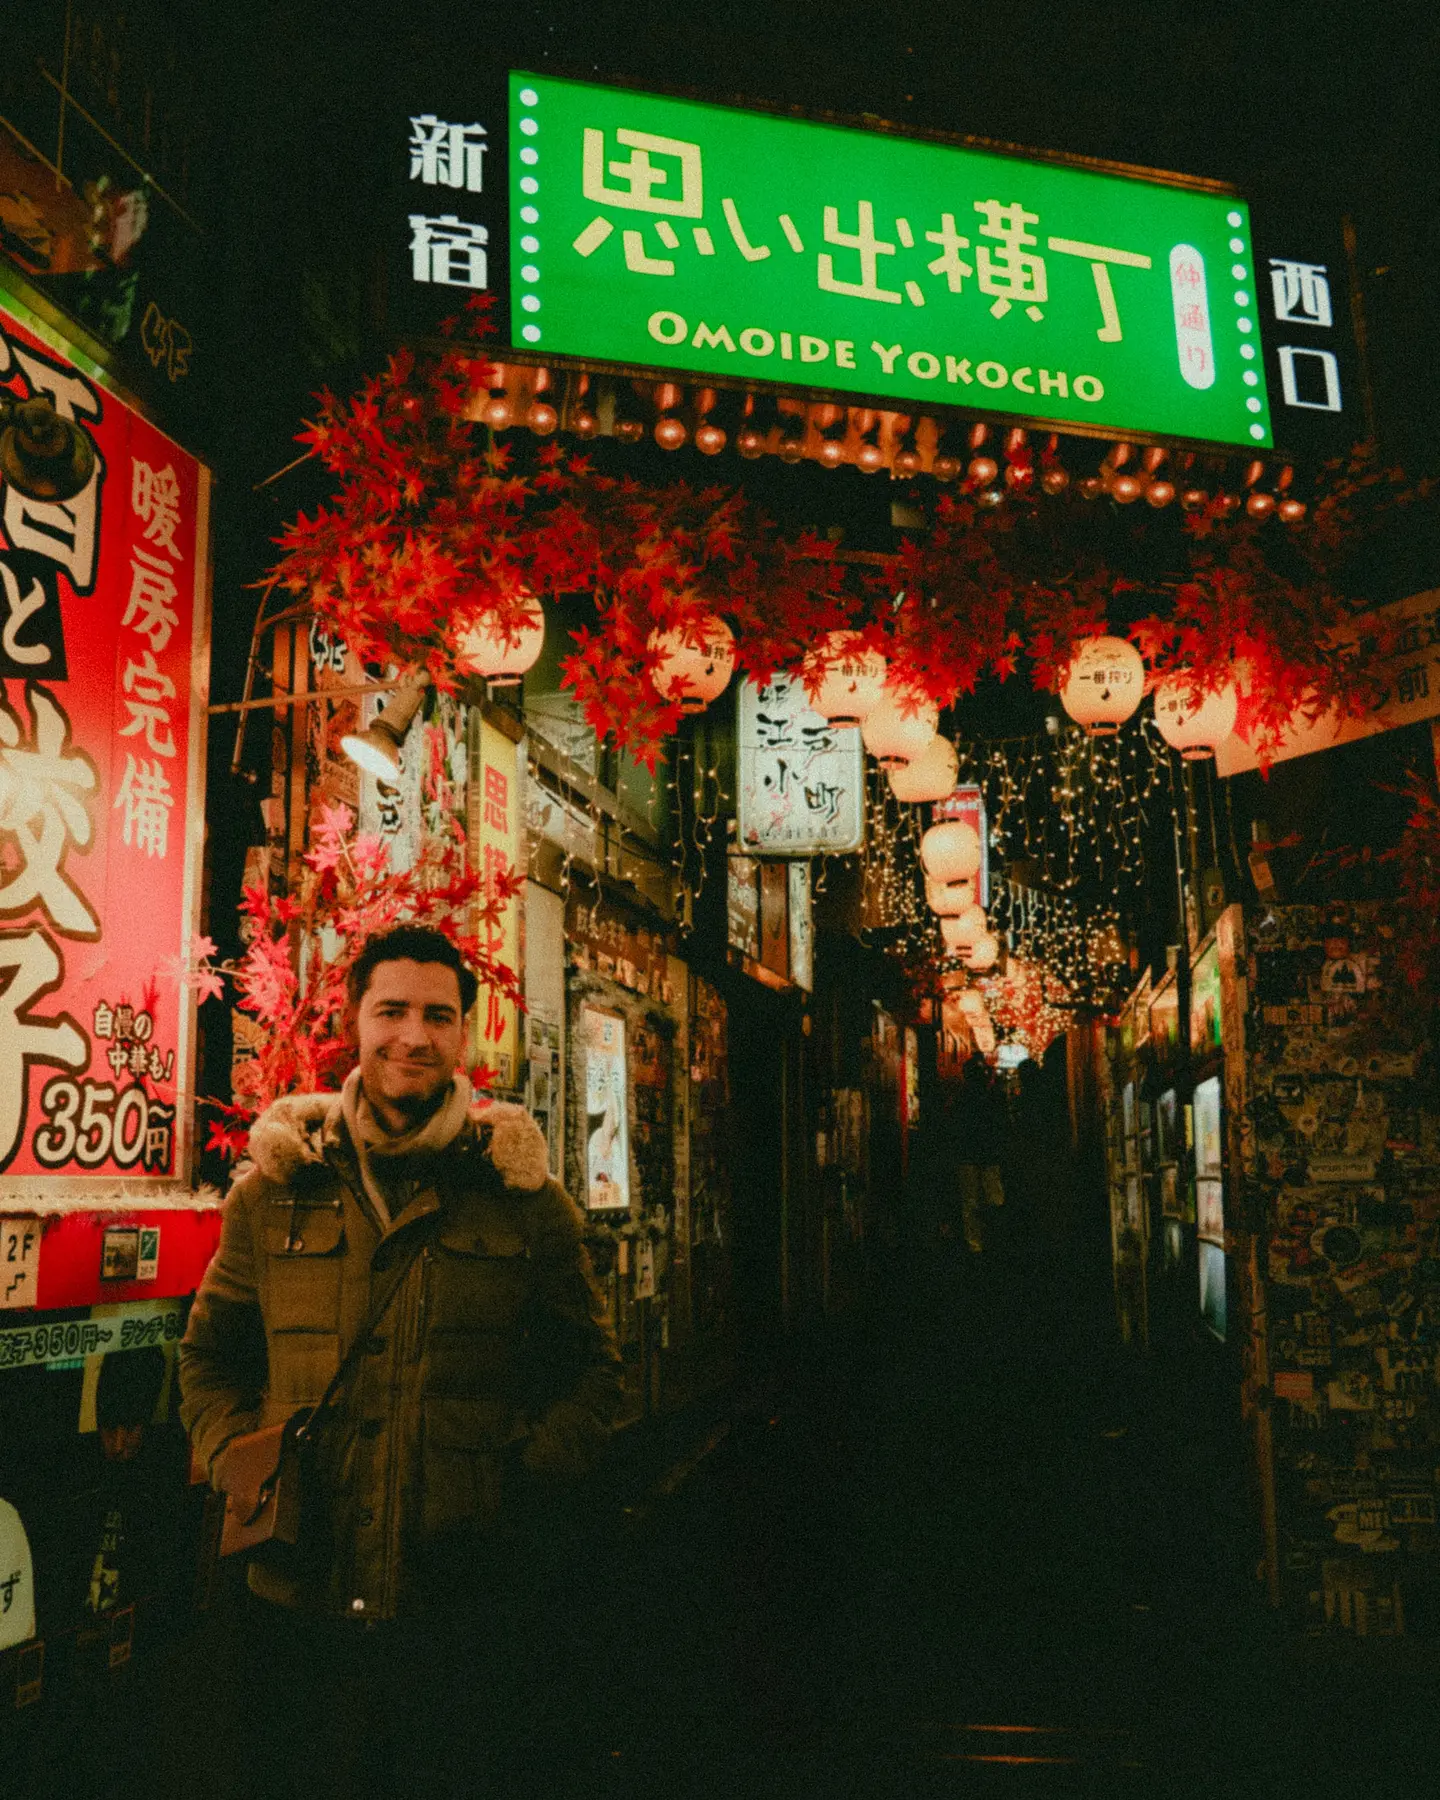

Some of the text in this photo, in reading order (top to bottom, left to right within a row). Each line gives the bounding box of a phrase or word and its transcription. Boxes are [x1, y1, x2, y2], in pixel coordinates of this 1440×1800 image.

[408, 114, 489, 290] 新宿
[572, 127, 1152, 344] 思い出横丁
[647, 310, 1105, 403] OMOIDE YOKOCHO
[1268, 258, 1342, 413] 西口
[113, 456, 184, 859] 暖房完備
[92, 1002, 154, 1040] 自慢の
[7, 1232, 34, 1262] 2F
